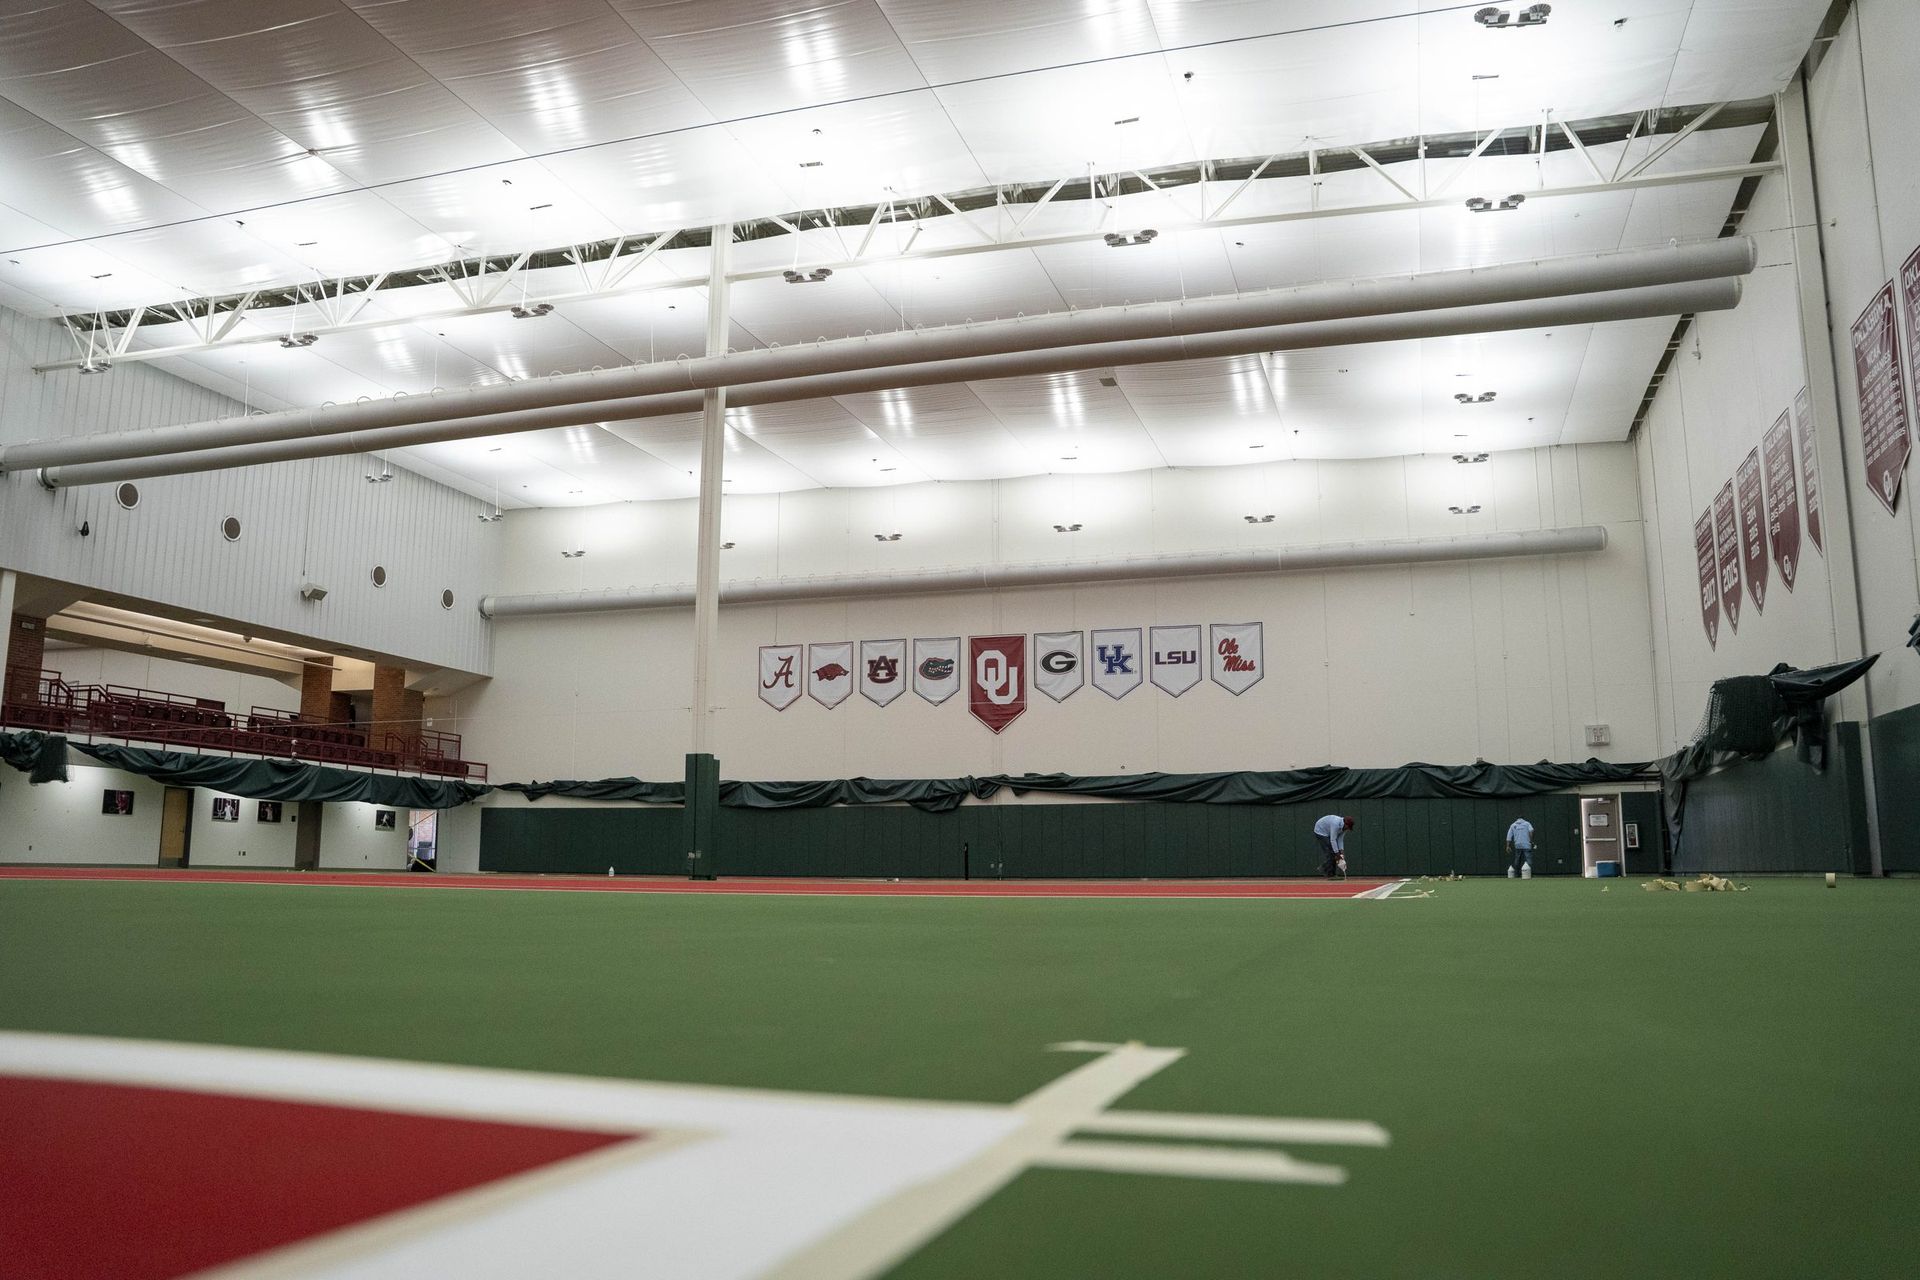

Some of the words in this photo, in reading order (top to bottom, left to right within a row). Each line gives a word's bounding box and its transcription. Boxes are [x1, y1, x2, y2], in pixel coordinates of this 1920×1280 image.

[1154, 650, 1197, 665] LSU
[1218, 638, 1239, 655] Ole
[763, 655, 794, 688] A
[1041, 650, 1078, 675] G
[1096, 644, 1133, 675] UK
[1222, 655, 1256, 672] Miss
[976, 649, 1018, 705] OU
